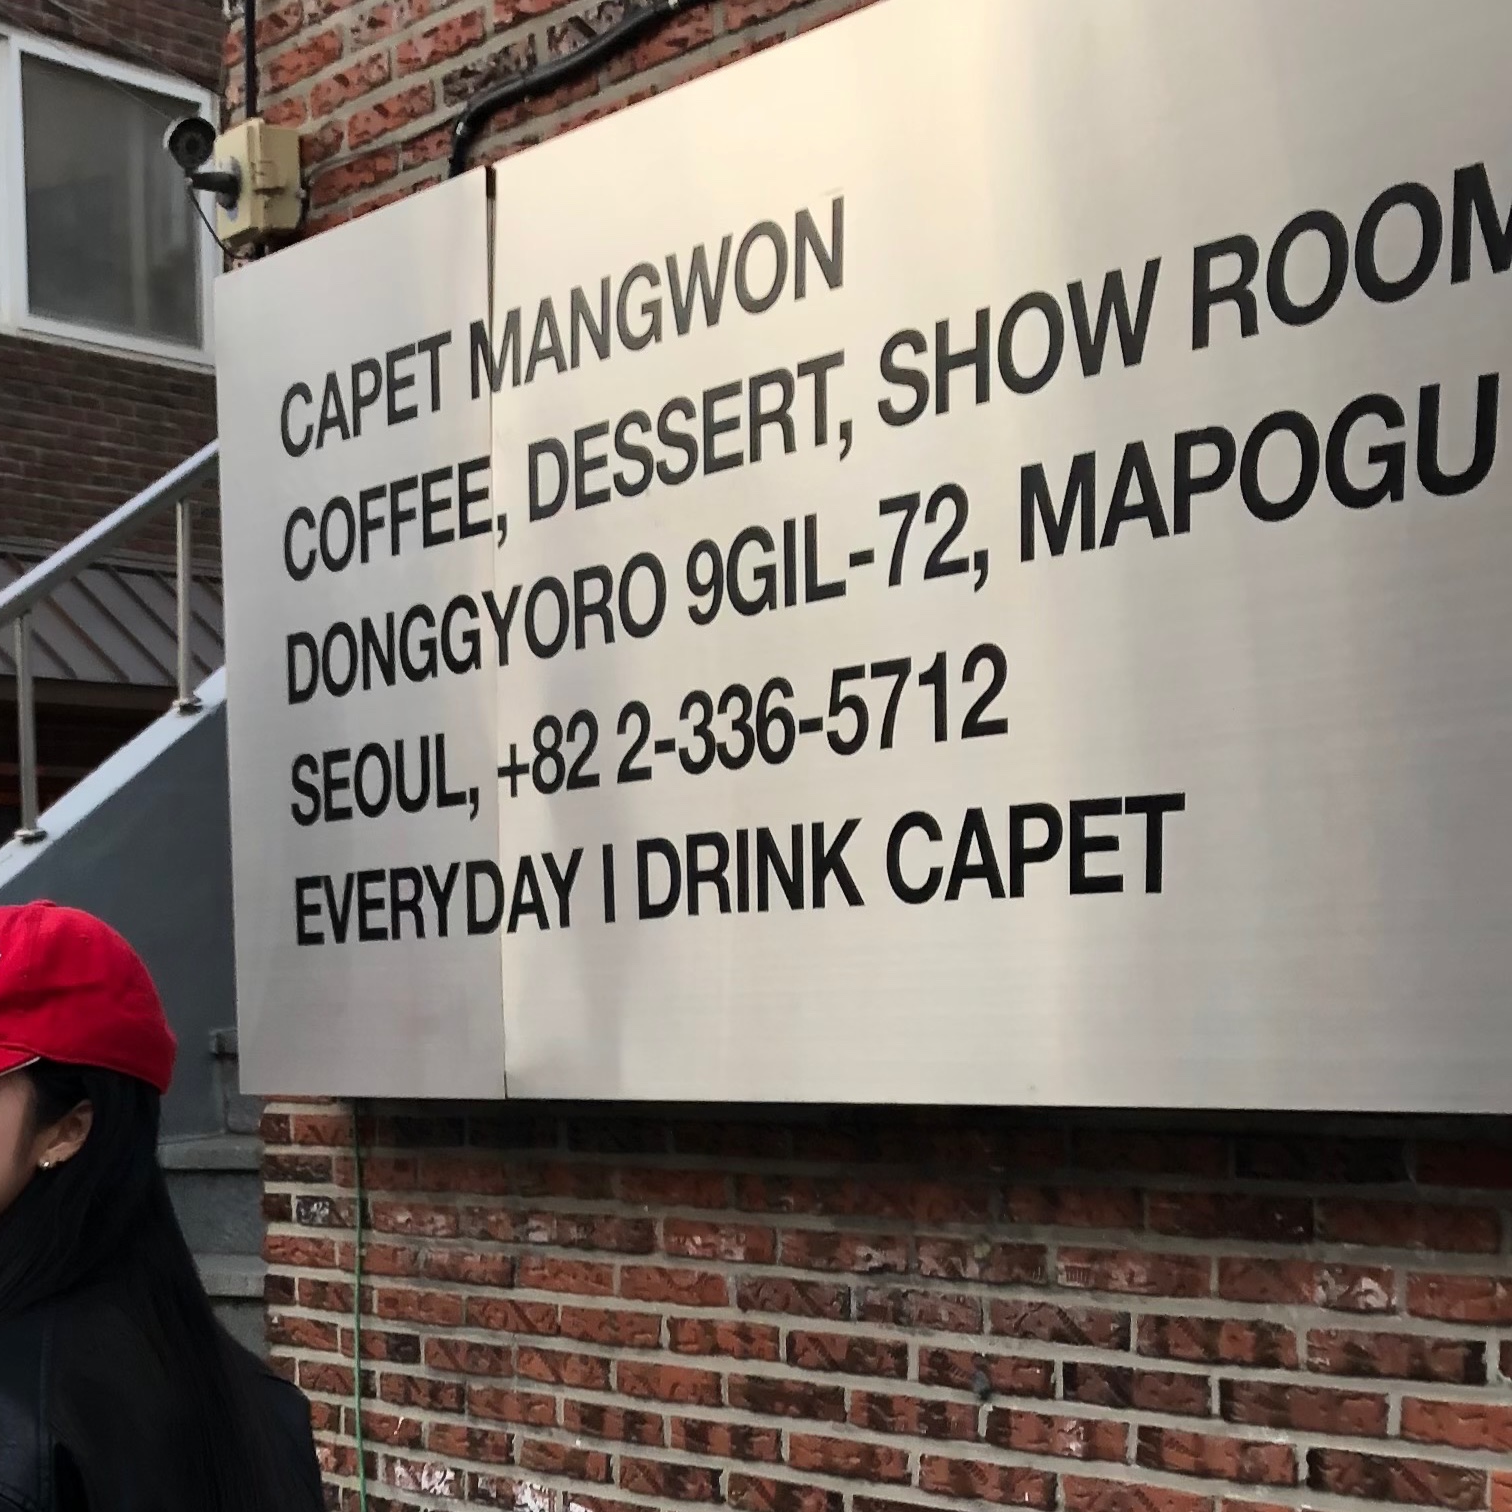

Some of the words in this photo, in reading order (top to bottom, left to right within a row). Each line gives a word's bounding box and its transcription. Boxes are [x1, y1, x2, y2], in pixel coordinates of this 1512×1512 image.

[279, 331, 452, 458] CAPET
[469, 195, 846, 400] MANGWON
[282, 455, 508, 582] COFFEE,
[527, 349, 853, 524] DESSERT,
[878, 256, 1162, 427] SHOW
[1190, 161, 1512, 352] ROOM
[285, 564, 667, 706] DONGGYORO
[685, 482, 991, 627] 9GIL-72,
[1019, 372, 1500, 564] MAPOGU
[289, 733, 481, 827] SEOUL,
[496, 709, 600, 798] +82
[615, 642, 1009, 785] 2-336-5712
[293, 844, 585, 948] EVERYDAY
[601, 842, 616, 924] I
[635, 816, 864, 921] DRINK
[885, 791, 1187, 906] CAPET
